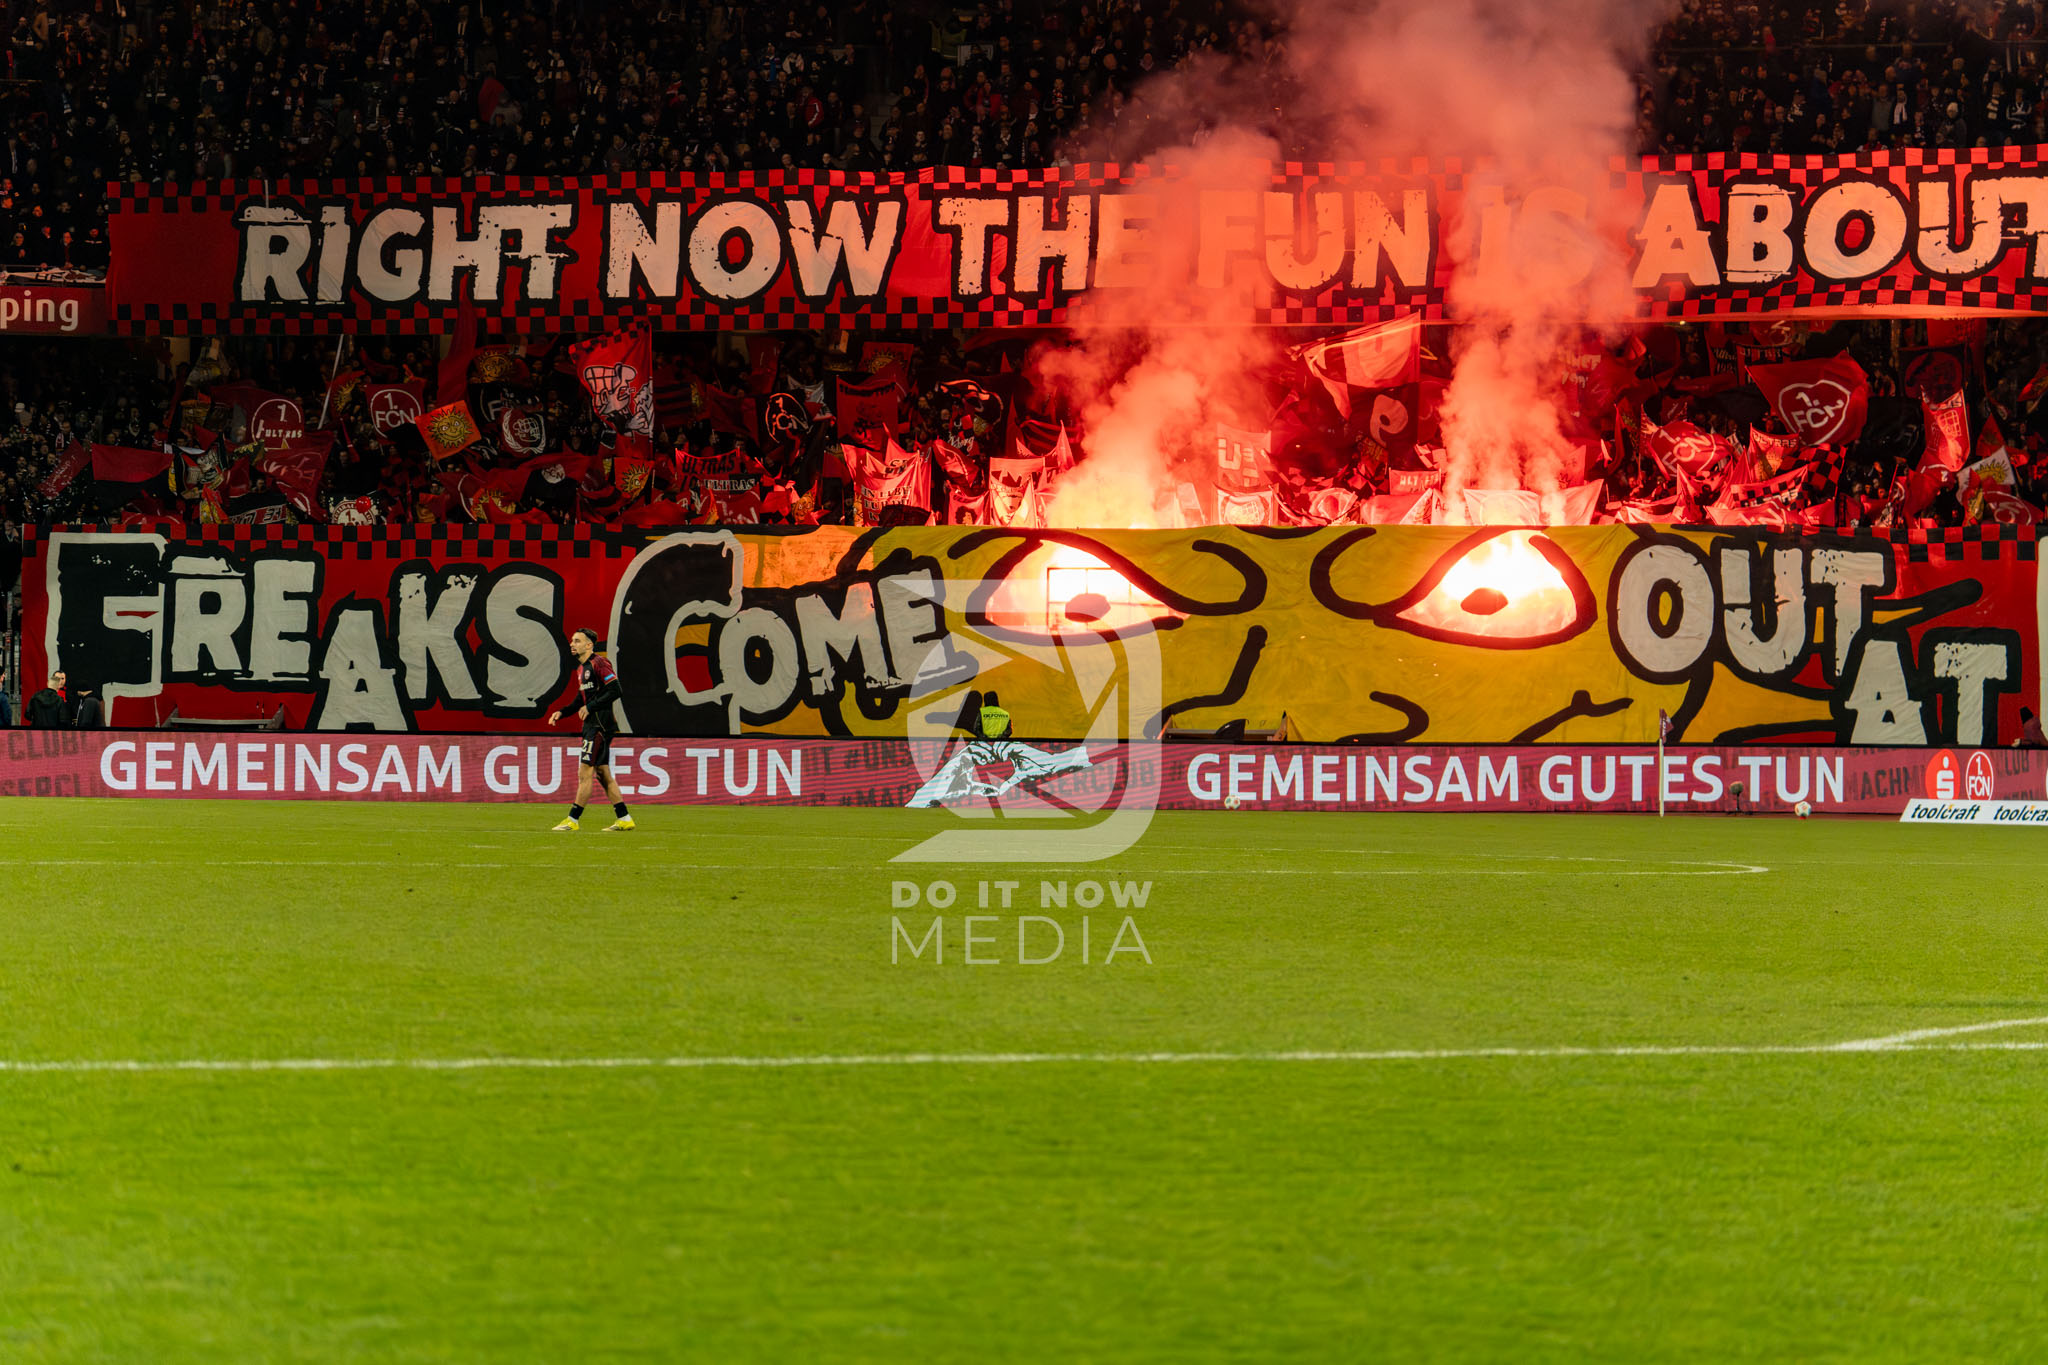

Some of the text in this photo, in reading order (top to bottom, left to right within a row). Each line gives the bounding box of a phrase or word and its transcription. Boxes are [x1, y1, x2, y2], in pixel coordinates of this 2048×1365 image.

[239, 203, 572, 303] RIGHT
[606, 200, 901, 300] NOW
[938, 195, 1165, 294] THE
[1201, 190, 1430, 290] FUN
[375, 407, 416, 428] FCN
[1791, 399, 1845, 432] FCN
[47, 531, 557, 731] FREAKS
[607, 528, 948, 735] COME
[1616, 544, 1885, 677] OUT
[1844, 640, 2008, 745] AT
[100, 741, 462, 794] GEMEINSAM
[690, 748, 801, 797] TUN
[1187, 752, 1519, 801] GEMEINSAM
[1538, 755, 1724, 803] GUTES
[1738, 755, 1844, 803] TUN
[1969, 780, 1991, 797] FCN
[1911, 803, 1980, 820] toolcraft
